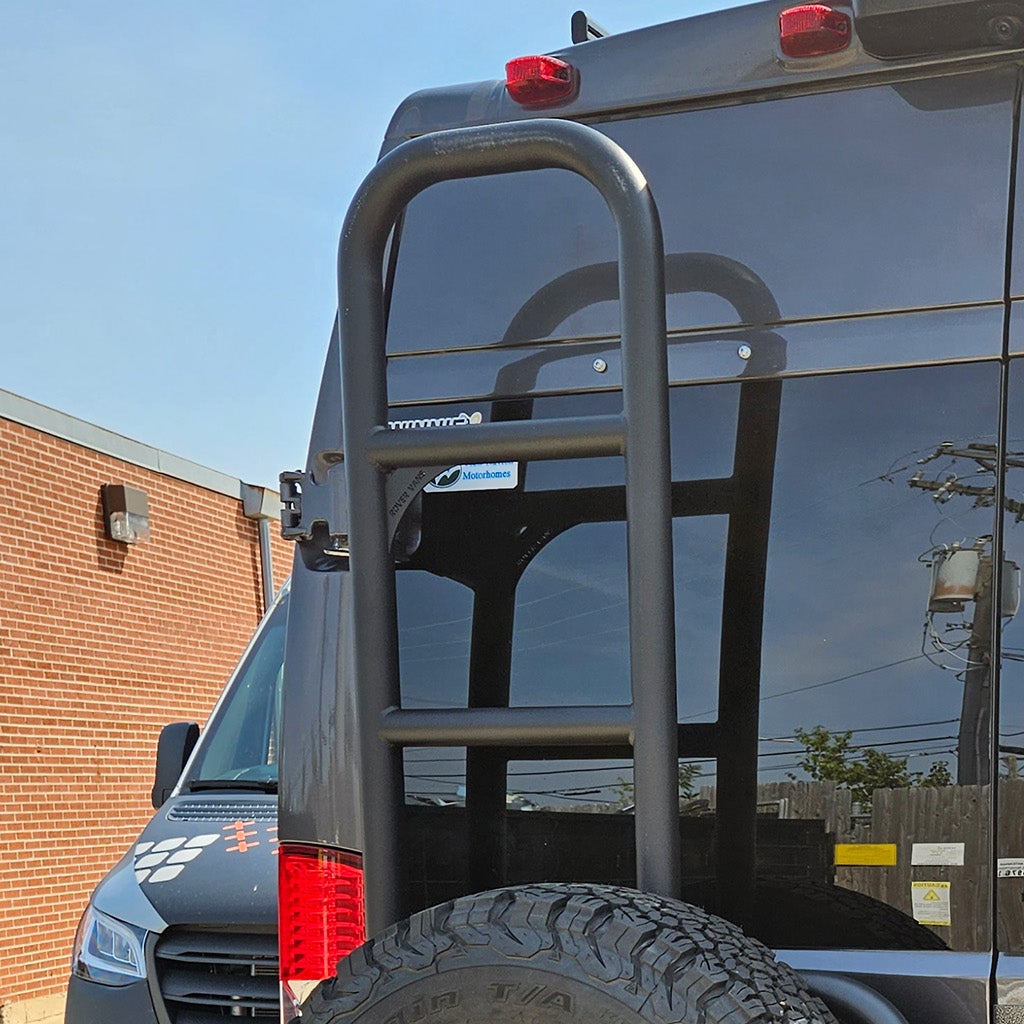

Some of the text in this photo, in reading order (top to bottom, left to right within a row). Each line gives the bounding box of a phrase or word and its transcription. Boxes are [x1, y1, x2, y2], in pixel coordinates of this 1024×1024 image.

[462, 470, 511, 480] Motorhomes
[389, 469, 427, 517] ROVER VANS
[489, 981, 577, 1012] T/A
